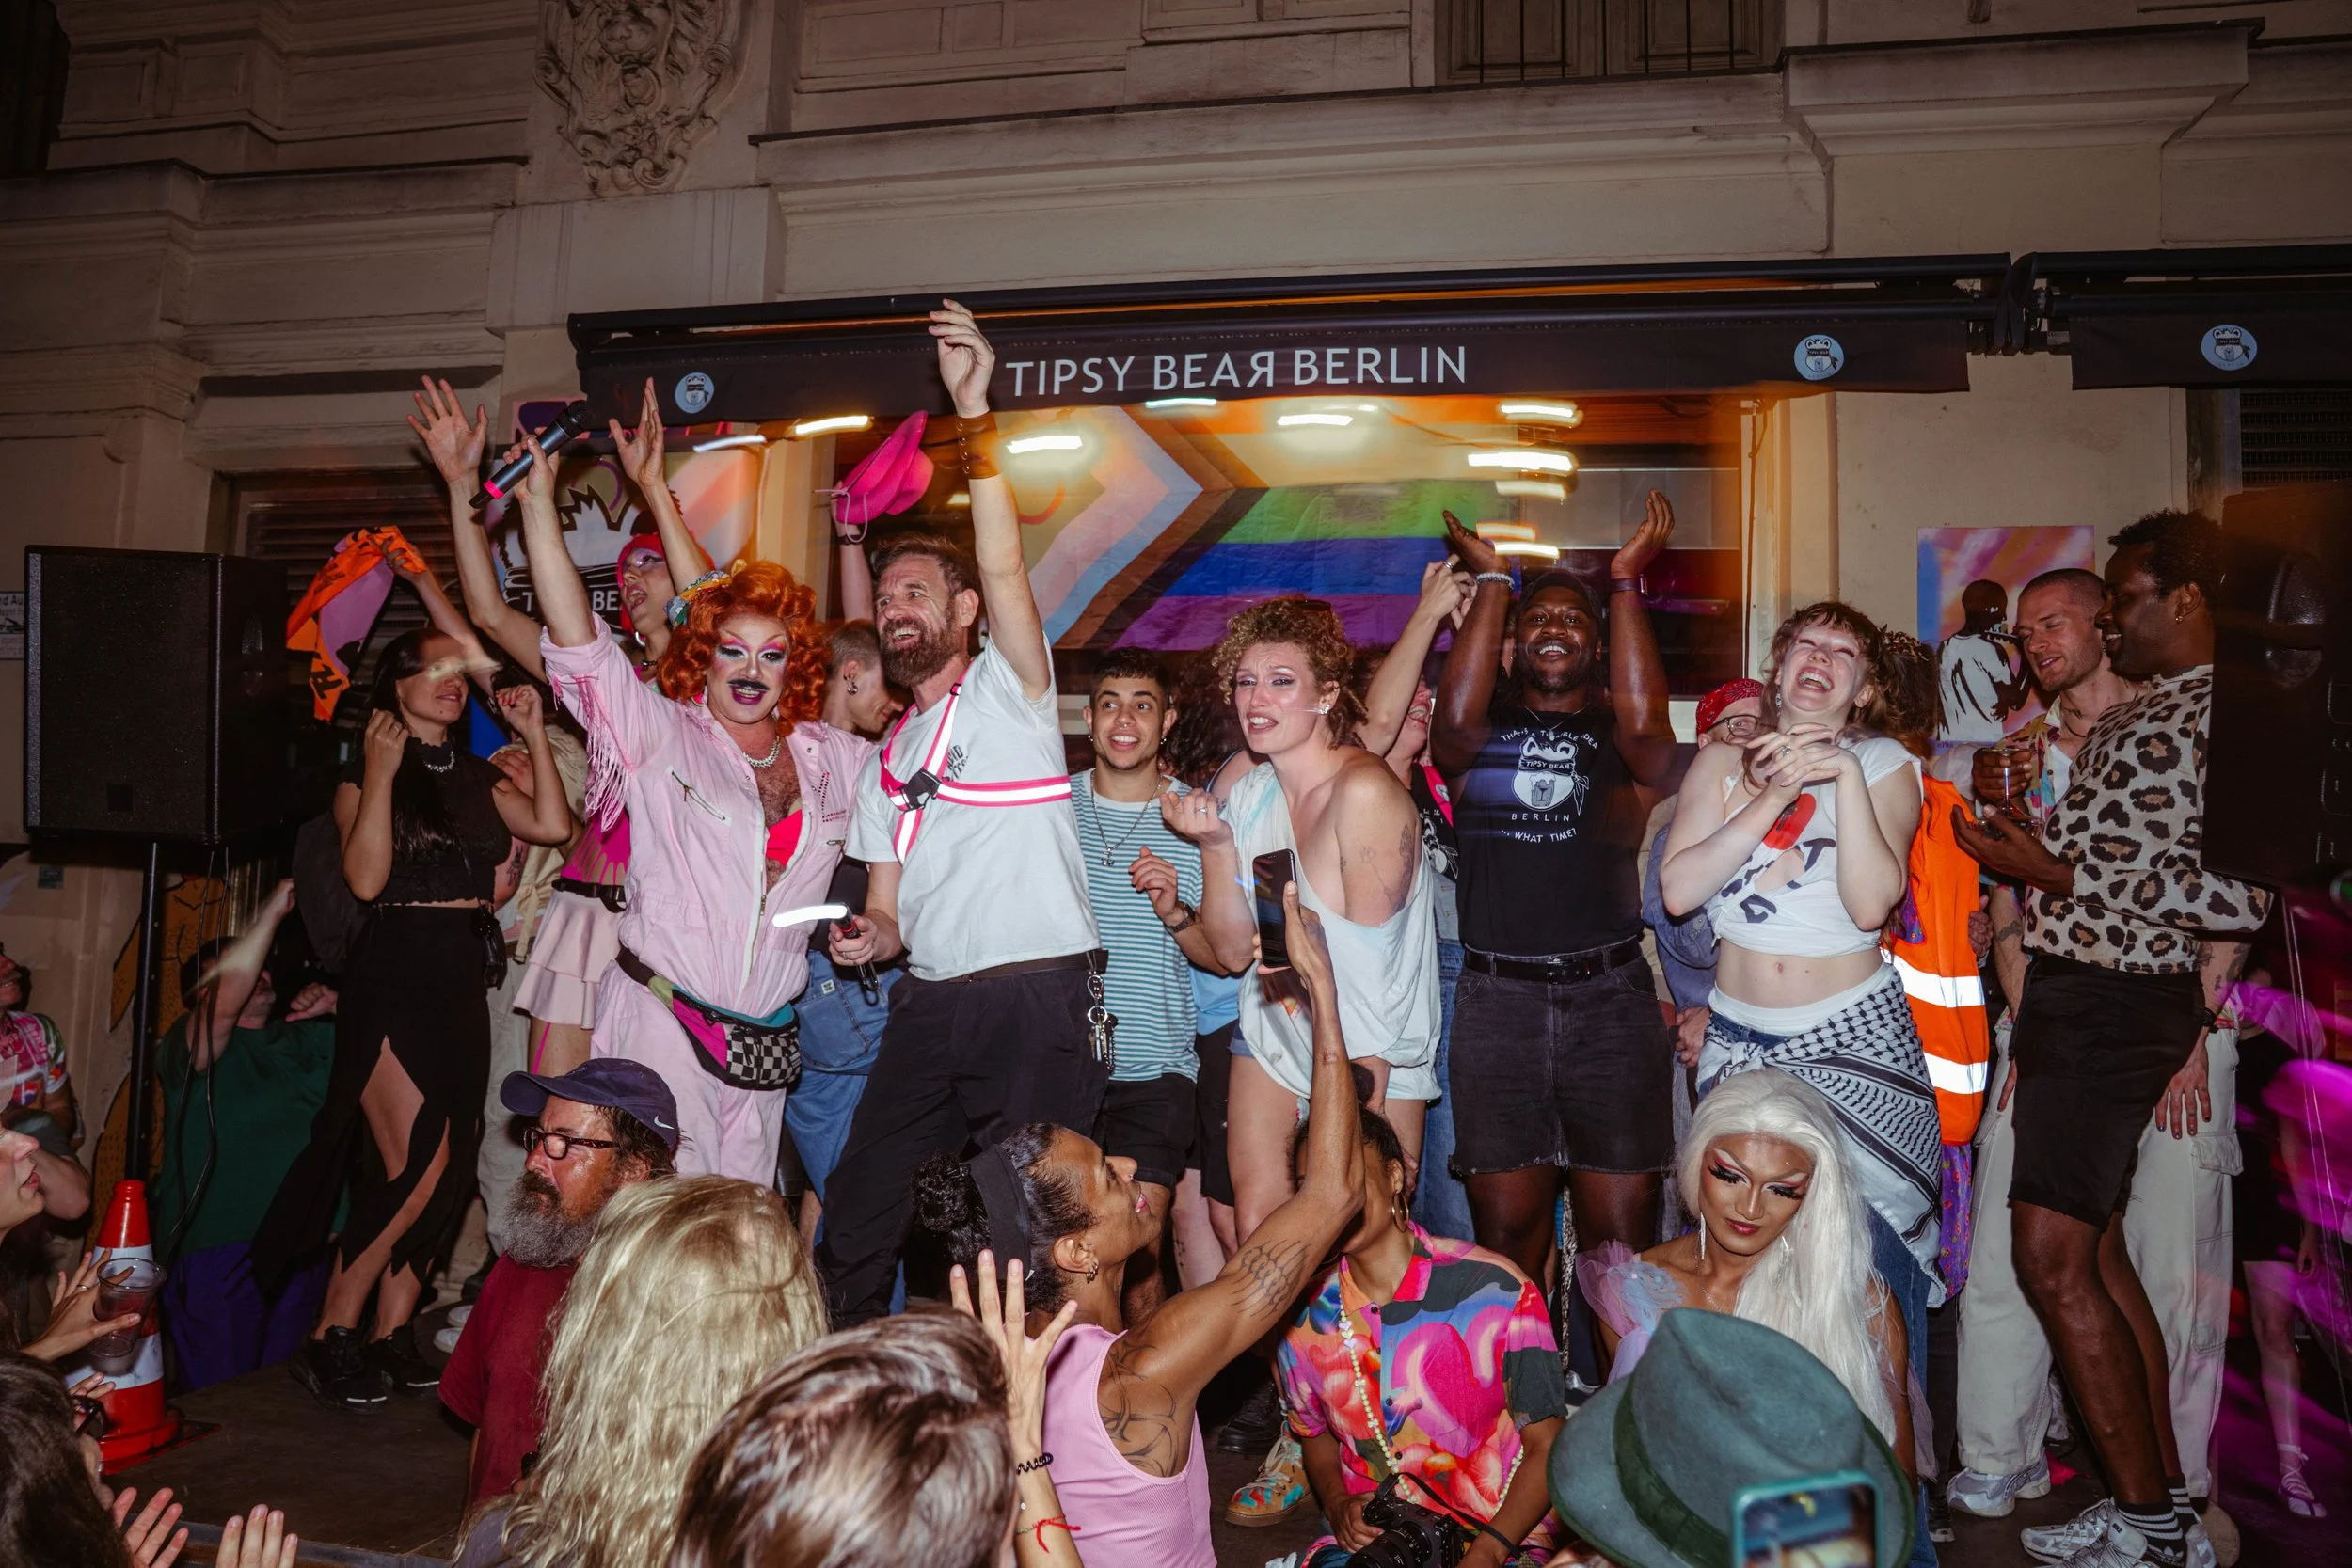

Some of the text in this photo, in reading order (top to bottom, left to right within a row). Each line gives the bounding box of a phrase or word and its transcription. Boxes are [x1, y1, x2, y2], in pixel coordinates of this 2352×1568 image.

[1006, 356, 1135, 396] TIPSY
[1294, 346, 1466, 385] BERLIN
[1526, 760, 1548, 768] TIPSY
[1511, 813, 1570, 822] BERLIN
[1514, 831, 1544, 844] WHAT
[1549, 828, 1577, 842] TIME?
